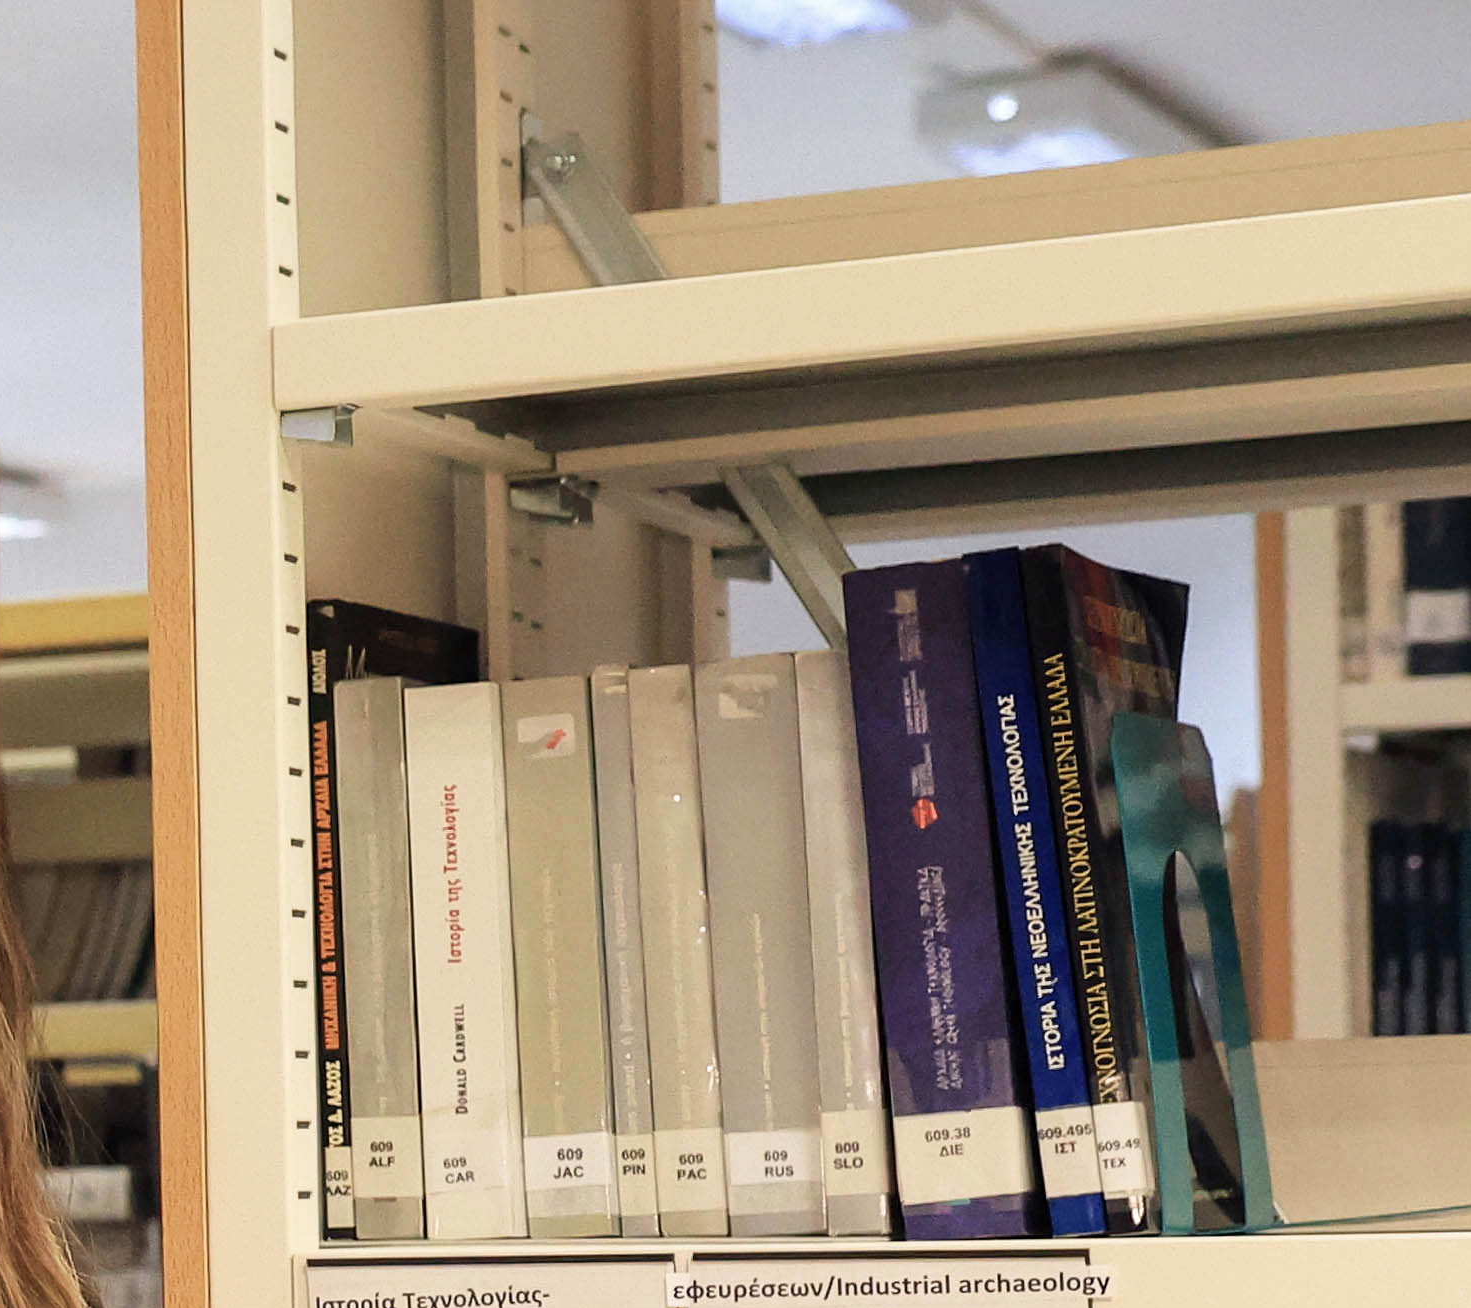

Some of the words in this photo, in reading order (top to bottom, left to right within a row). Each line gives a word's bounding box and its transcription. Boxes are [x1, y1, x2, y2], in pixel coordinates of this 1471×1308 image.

[997, 694, 1030, 817] ΤΕΧΝΟΛΟΓΙΑΣ
[1014, 821, 1050, 958] ΝΕΟΕΛΛΗΝΙΚΗΣ
[1034, 963, 1057, 999] ΤΗΣ
[1040, 1000, 1064, 1070] ΙΣΤΟΡΙΑ
[925, 1127, 971, 1141] 609.38
[939, 1144, 964, 1156] ΔΙΕ
[443, 1158, 467, 1169] 609
[623, 1164, 646, 1175] PIN
[445, 1171, 475, 1184] CAR
[553, 1165, 584, 1179] JAC
[673, 1275, 950, 1303] εφευρέσεων/Industrial
[958, 1272, 1110, 1296] archaeology
